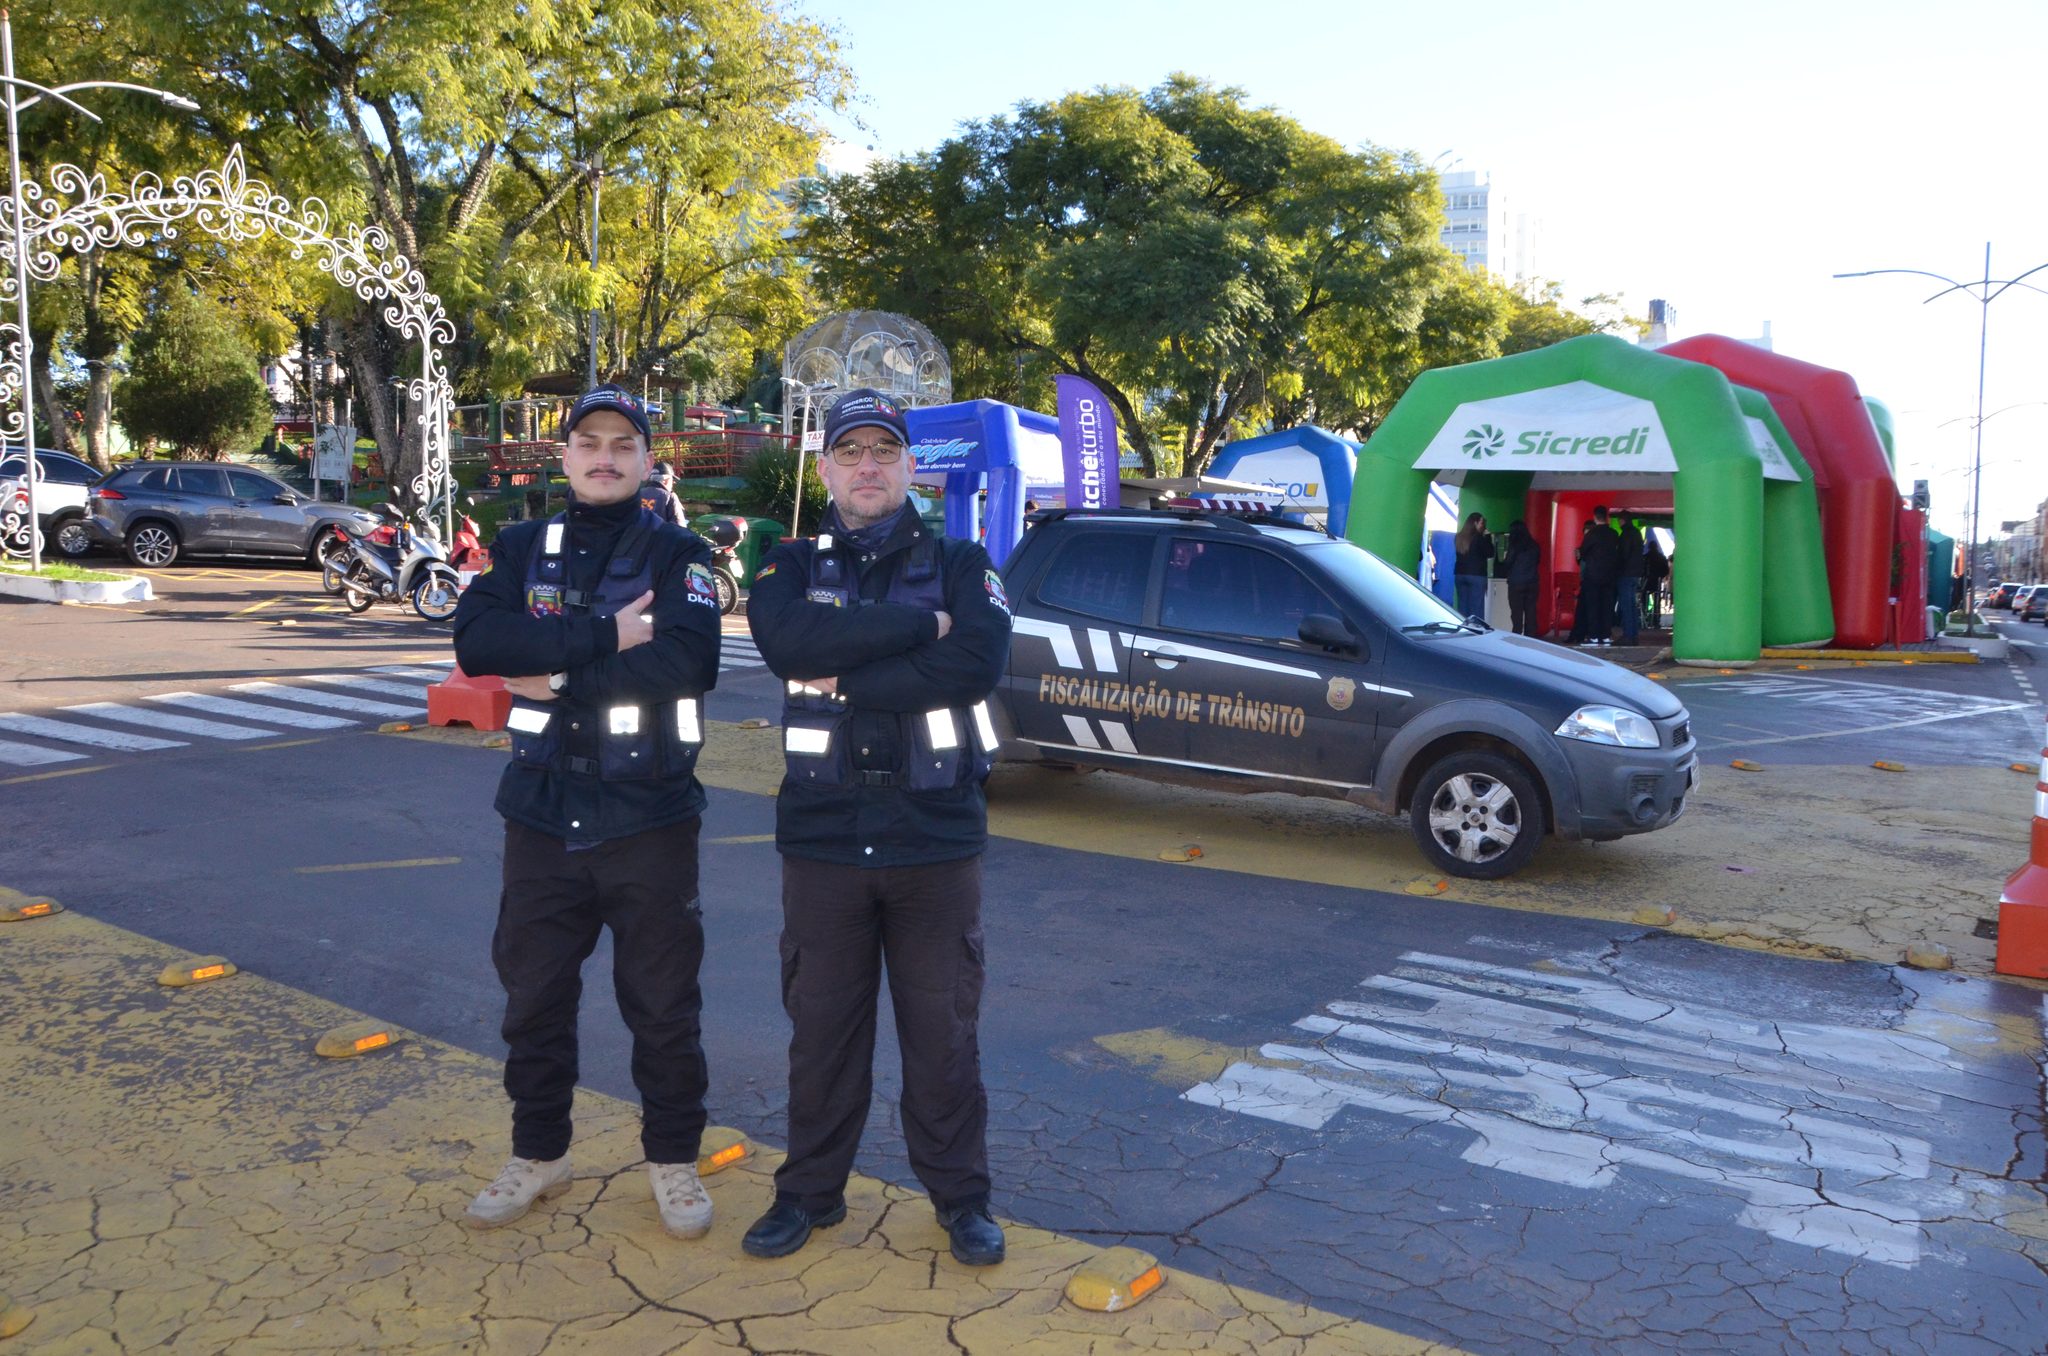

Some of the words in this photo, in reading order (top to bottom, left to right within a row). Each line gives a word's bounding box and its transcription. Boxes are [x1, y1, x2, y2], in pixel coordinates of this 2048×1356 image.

[807, 432, 824, 441] TAX
[1511, 426, 1650, 456] Sicredi
[687, 593, 716, 608] DMT
[1039, 674, 1170, 722] FISCALIZAÇÃO
[1175, 693, 1200, 723] DE
[1208, 692, 1305, 738] TRÂNSITO
